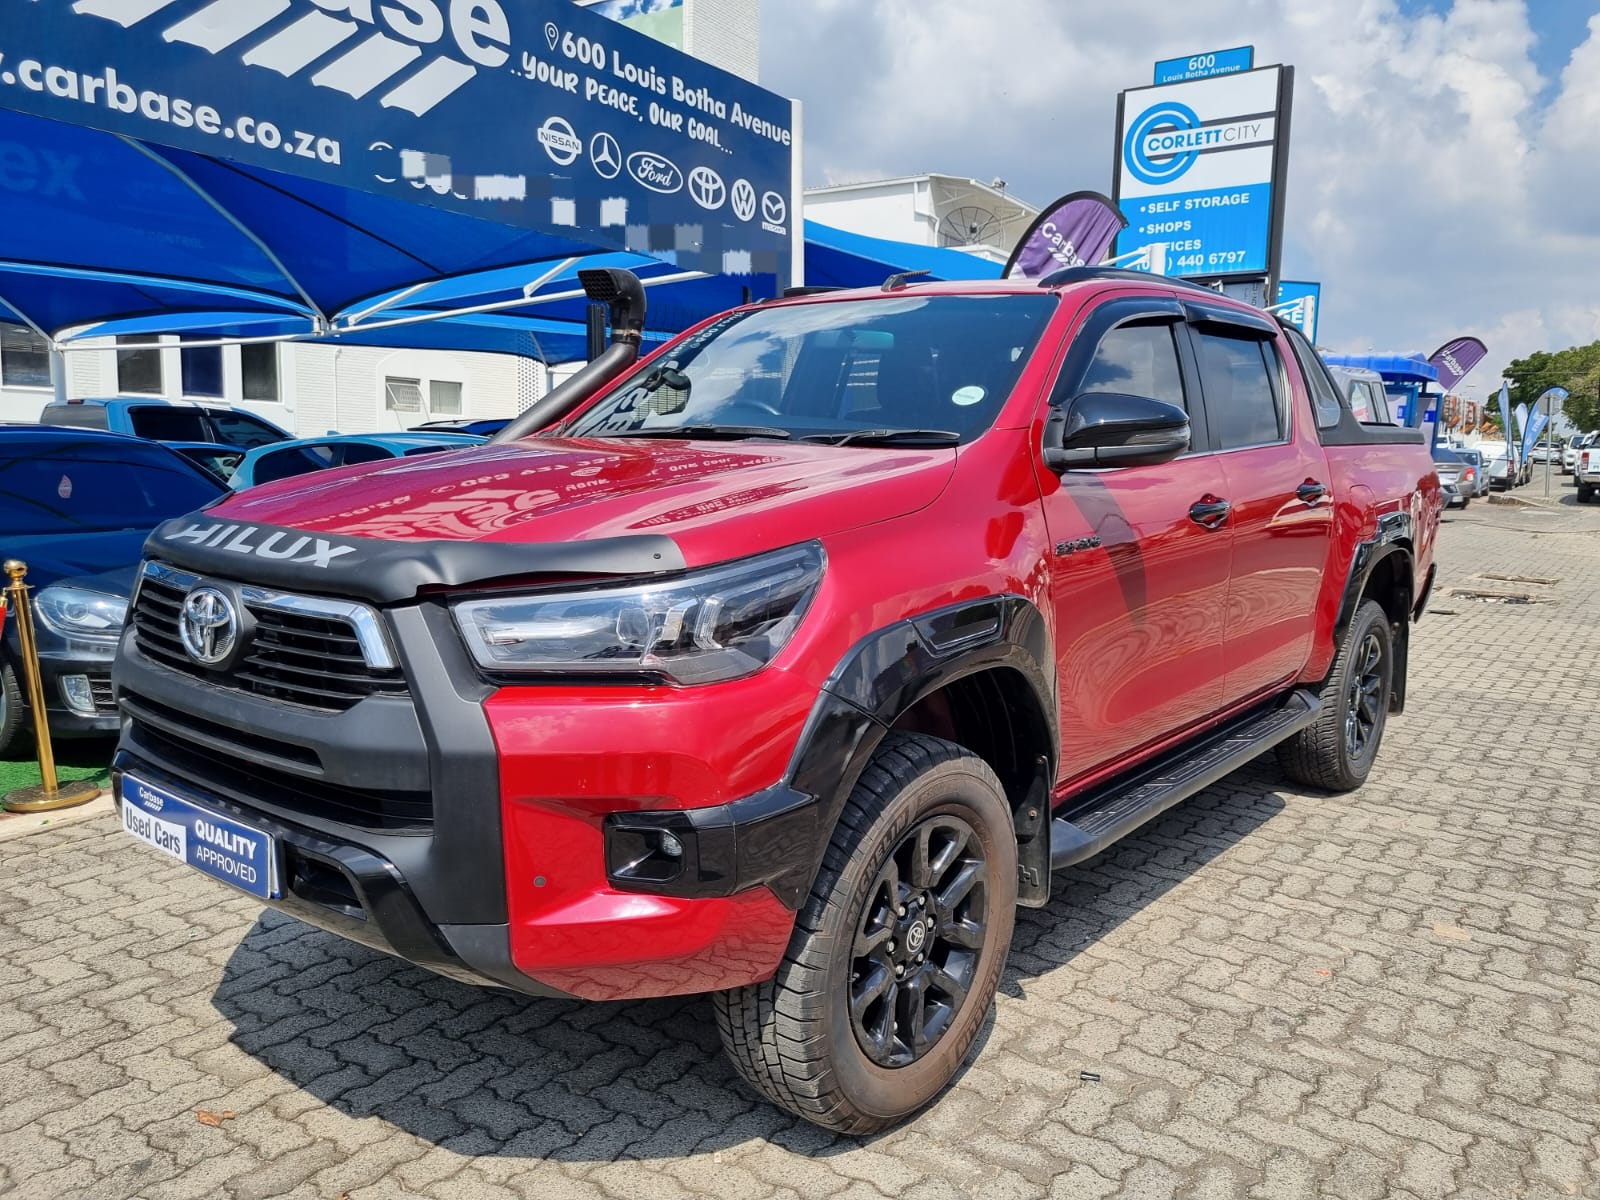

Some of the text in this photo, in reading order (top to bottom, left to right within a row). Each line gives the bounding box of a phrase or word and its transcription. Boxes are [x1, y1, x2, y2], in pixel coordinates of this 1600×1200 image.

[1163, 65, 1241, 83] Louis Botha Avenue
[1188, 54, 1216, 71] 600
[562, 31, 791, 146] 600 Louis Botha Avenue
[649, 102, 683, 133] OUR
[540, 130, 580, 151] NISSAN
[637, 156, 673, 187] Ford
[1148, 193, 1250, 214] SELF STORAGE
[1146, 220, 1192, 234] SHOPS
[1177, 254, 1204, 267] 440
[1209, 250, 1246, 265] 6797
[164, 524, 357, 569] HILUX
[139, 786, 164, 807] Carbase
[126, 806, 181, 855] Used Cars
[195, 818, 257, 860] QUALITY
[196, 845, 257, 884] APPROVED
